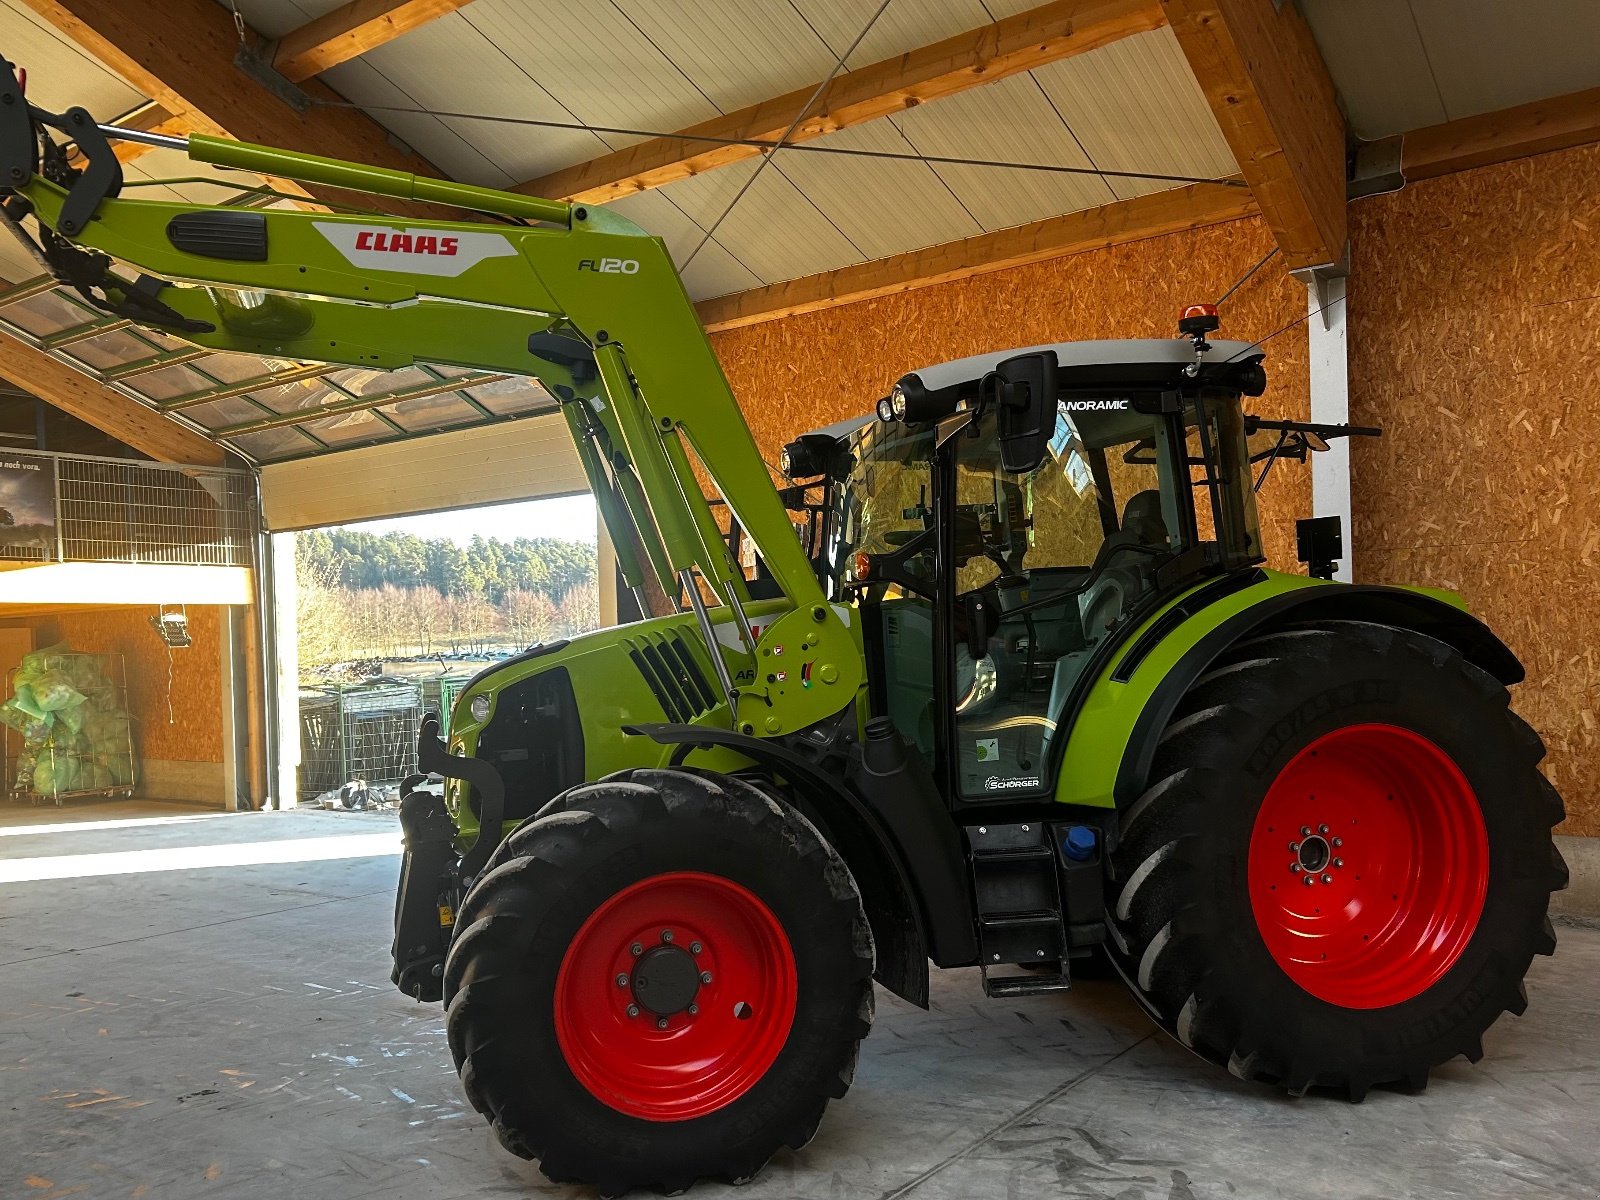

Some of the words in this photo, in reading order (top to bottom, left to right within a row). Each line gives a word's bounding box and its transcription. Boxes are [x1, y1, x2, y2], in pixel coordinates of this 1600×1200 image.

[355, 231, 459, 256] CLAAS
[577, 258, 640, 275] FL120
[1057, 400, 1129, 411] ANORAMIC
[735, 670, 758, 680] AR
